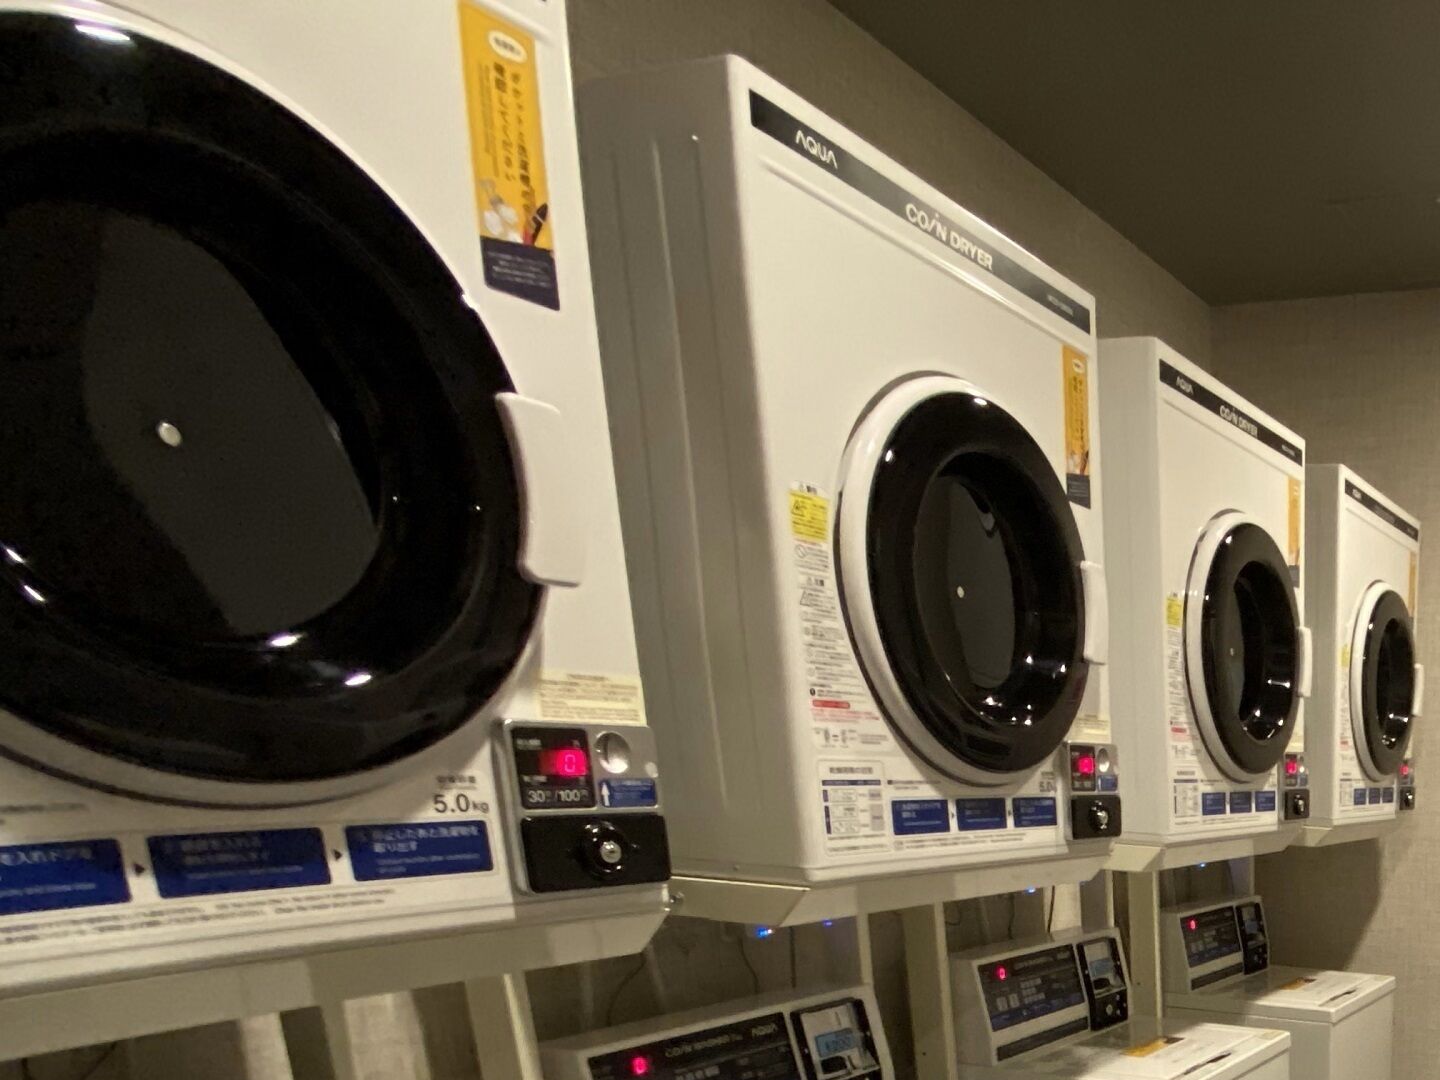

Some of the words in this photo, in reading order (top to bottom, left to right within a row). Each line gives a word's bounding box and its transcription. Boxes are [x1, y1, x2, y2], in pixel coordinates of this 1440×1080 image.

[795, 129, 838, 169] AQUA
[905, 203, 948, 242] COIN
[949, 230, 994, 271] DRYER
[433, 793, 490, 814] 5.0kg
